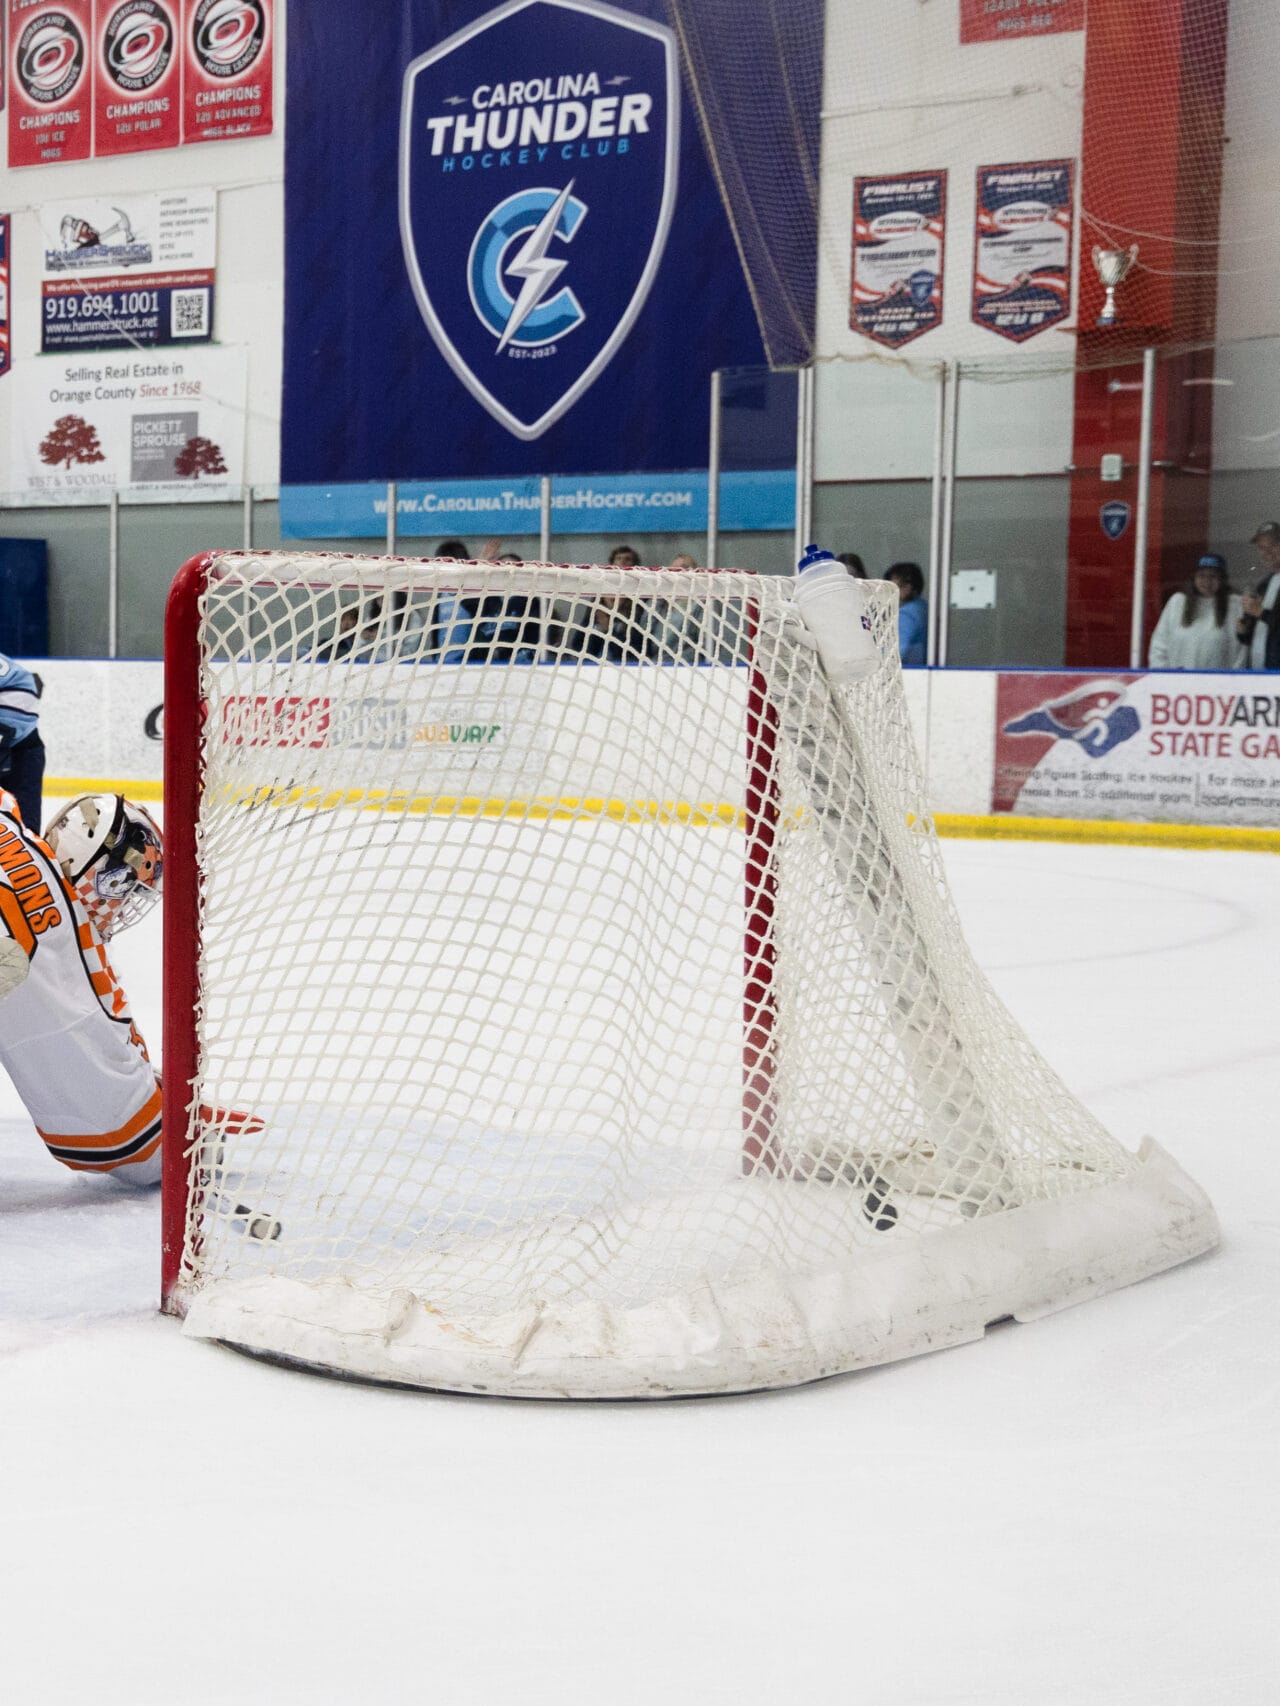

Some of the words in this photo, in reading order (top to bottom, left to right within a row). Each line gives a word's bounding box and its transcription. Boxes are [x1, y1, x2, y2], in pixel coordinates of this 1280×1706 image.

[195, 85, 261, 107] CHAMPIONS
[472, 71, 601, 110] CAROLINA
[106, 97, 169, 119] CHAMPIONS
[19, 110, 81, 131] CHAMPIONS
[426, 93, 653, 156] THUNDER
[442, 148, 549, 173] HOCKEY
[561, 138, 631, 160] CLUB
[45, 291, 160, 320] 919.694.1001
[46, 316, 158, 334] www.hammerstruck.net
[65, 367, 101, 383] Selling
[105, 365, 130, 379] Real
[133, 364, 169, 378] Estate
[172, 363, 184, 375] in
[49, 389, 91, 405] Orange
[94, 386, 136, 401] County
[139, 383, 168, 397] Since
[172, 381, 202, 396] 1968
[133, 419, 183, 435] PICKETT
[133, 433, 186, 448] SPROUSE
[65, 473, 118, 487] WOODALL
[1149, 731, 1231, 758] STATE
[1043, 768, 1077, 782] Figure
[1206, 773, 1226, 786] For
[1231, 776, 1268, 788] more
